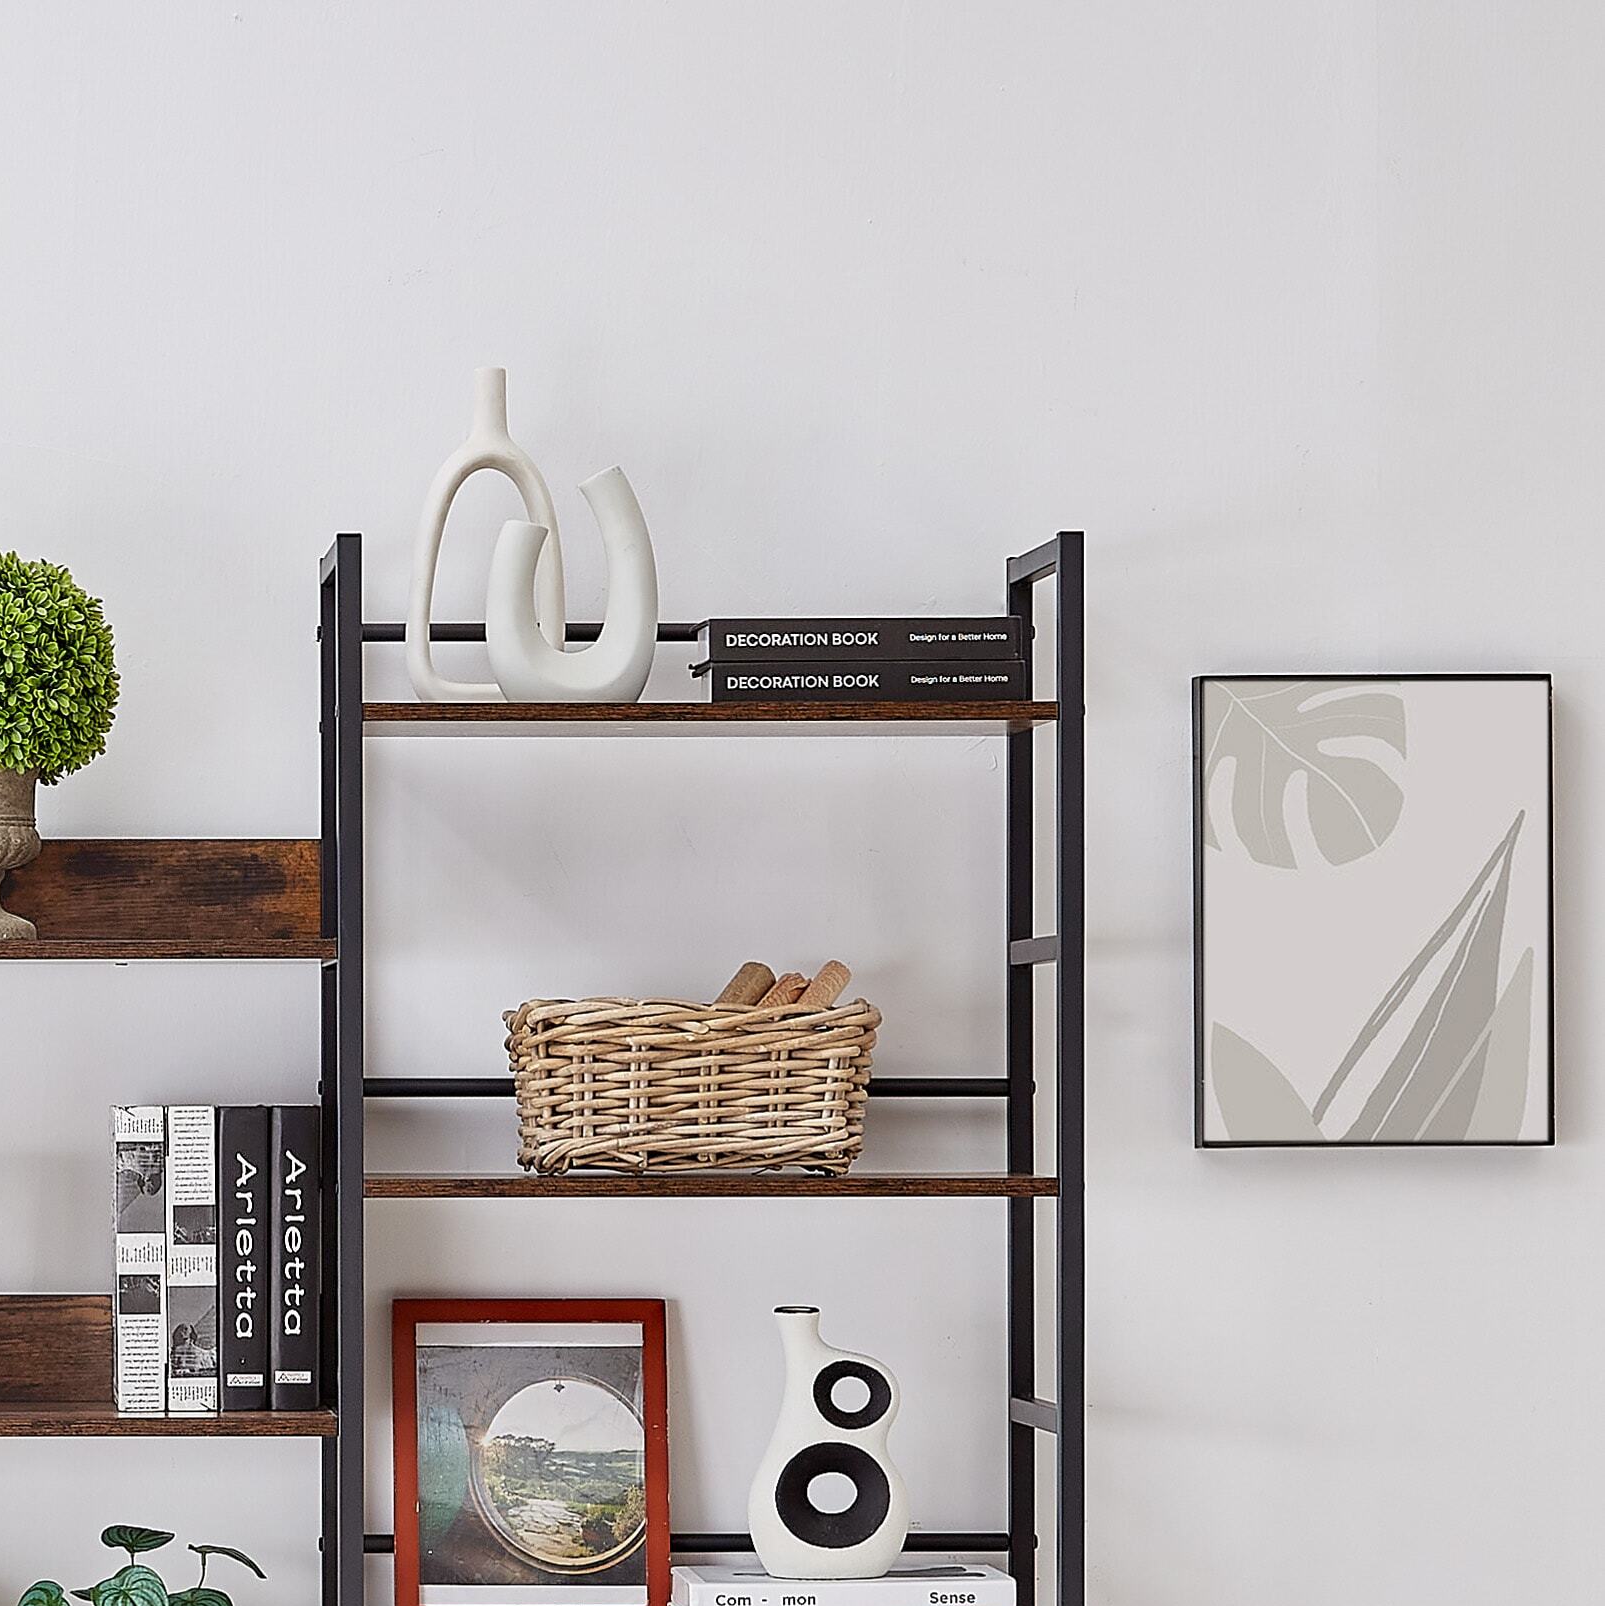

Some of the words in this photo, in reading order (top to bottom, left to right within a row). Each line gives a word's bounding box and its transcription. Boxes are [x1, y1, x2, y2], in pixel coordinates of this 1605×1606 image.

[726, 633, 829, 648] DECORATION
[831, 632, 879, 647] BOOK
[909, 633, 937, 643] Design
[938, 633, 950, 641] for
[958, 633, 982, 641] Better
[983, 632, 1008, 641] Home
[727, 676, 830, 690] DECORATION
[833, 675, 880, 689] BOOK
[910, 675, 938, 685] Design
[939, 675, 951, 683] for
[958, 675, 983, 683] Better
[983, 675, 1009, 683] Home
[235, 1152, 257, 1338] Arletta
[284, 1150, 307, 1336] Arletta
[715, 1594, 752, 1606] Com
[781, 1594, 817, 1606] mon
[929, 1591, 976, 1604] Sense
